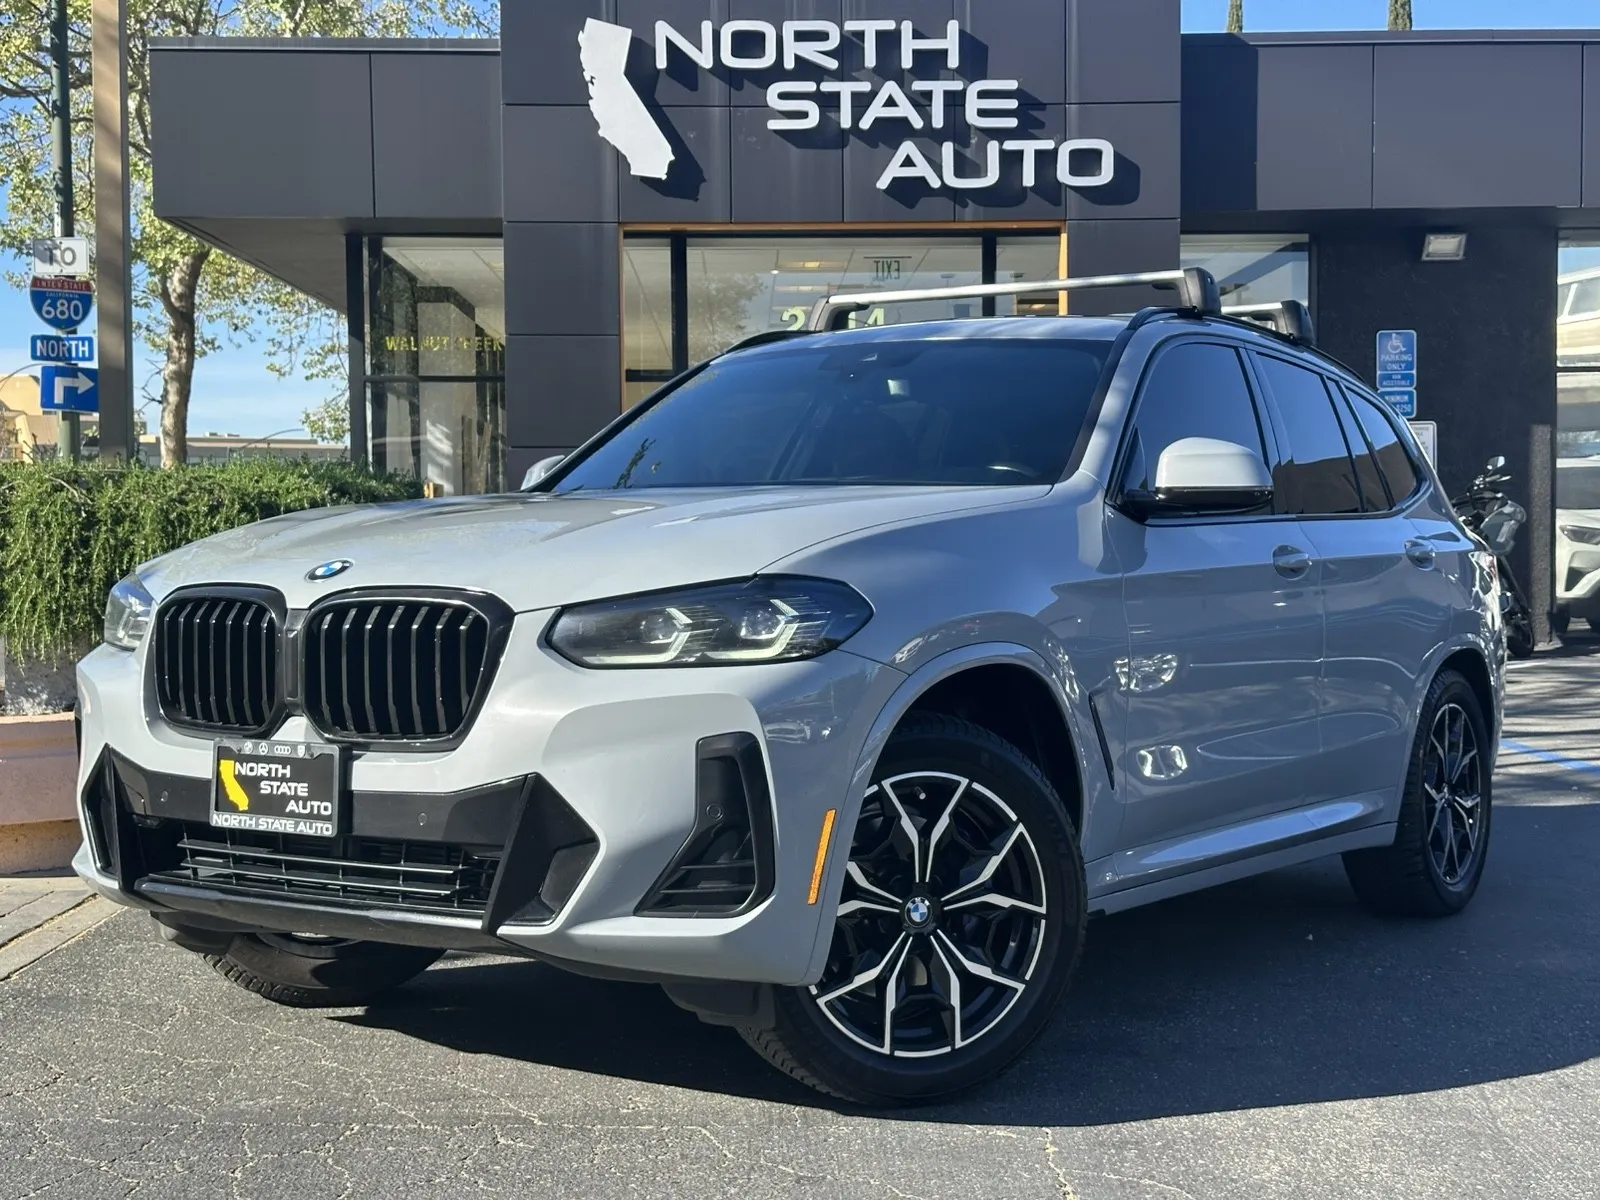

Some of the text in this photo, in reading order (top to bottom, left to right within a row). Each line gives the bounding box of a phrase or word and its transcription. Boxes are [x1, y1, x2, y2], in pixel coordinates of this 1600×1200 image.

[655, 19, 960, 71] NORTH
[766, 80, 1019, 131] STATE
[876, 138, 1115, 190] AUTO
[43, 246, 77, 266] TO
[37, 281, 87, 290] INTERSTATE
[45, 291, 80, 299] CALIFORNIA
[42, 299, 83, 320] 680
[36, 339, 89, 358] NORTH
[385, 336, 449, 351] WALNUT
[1380, 353, 1413, 362] PARKING
[234, 762, 291, 778] NORTH
[260, 780, 308, 796] STATE
[285, 800, 332, 815] AUTO
[212, 813, 332, 835] NORTH STATE AUTO
